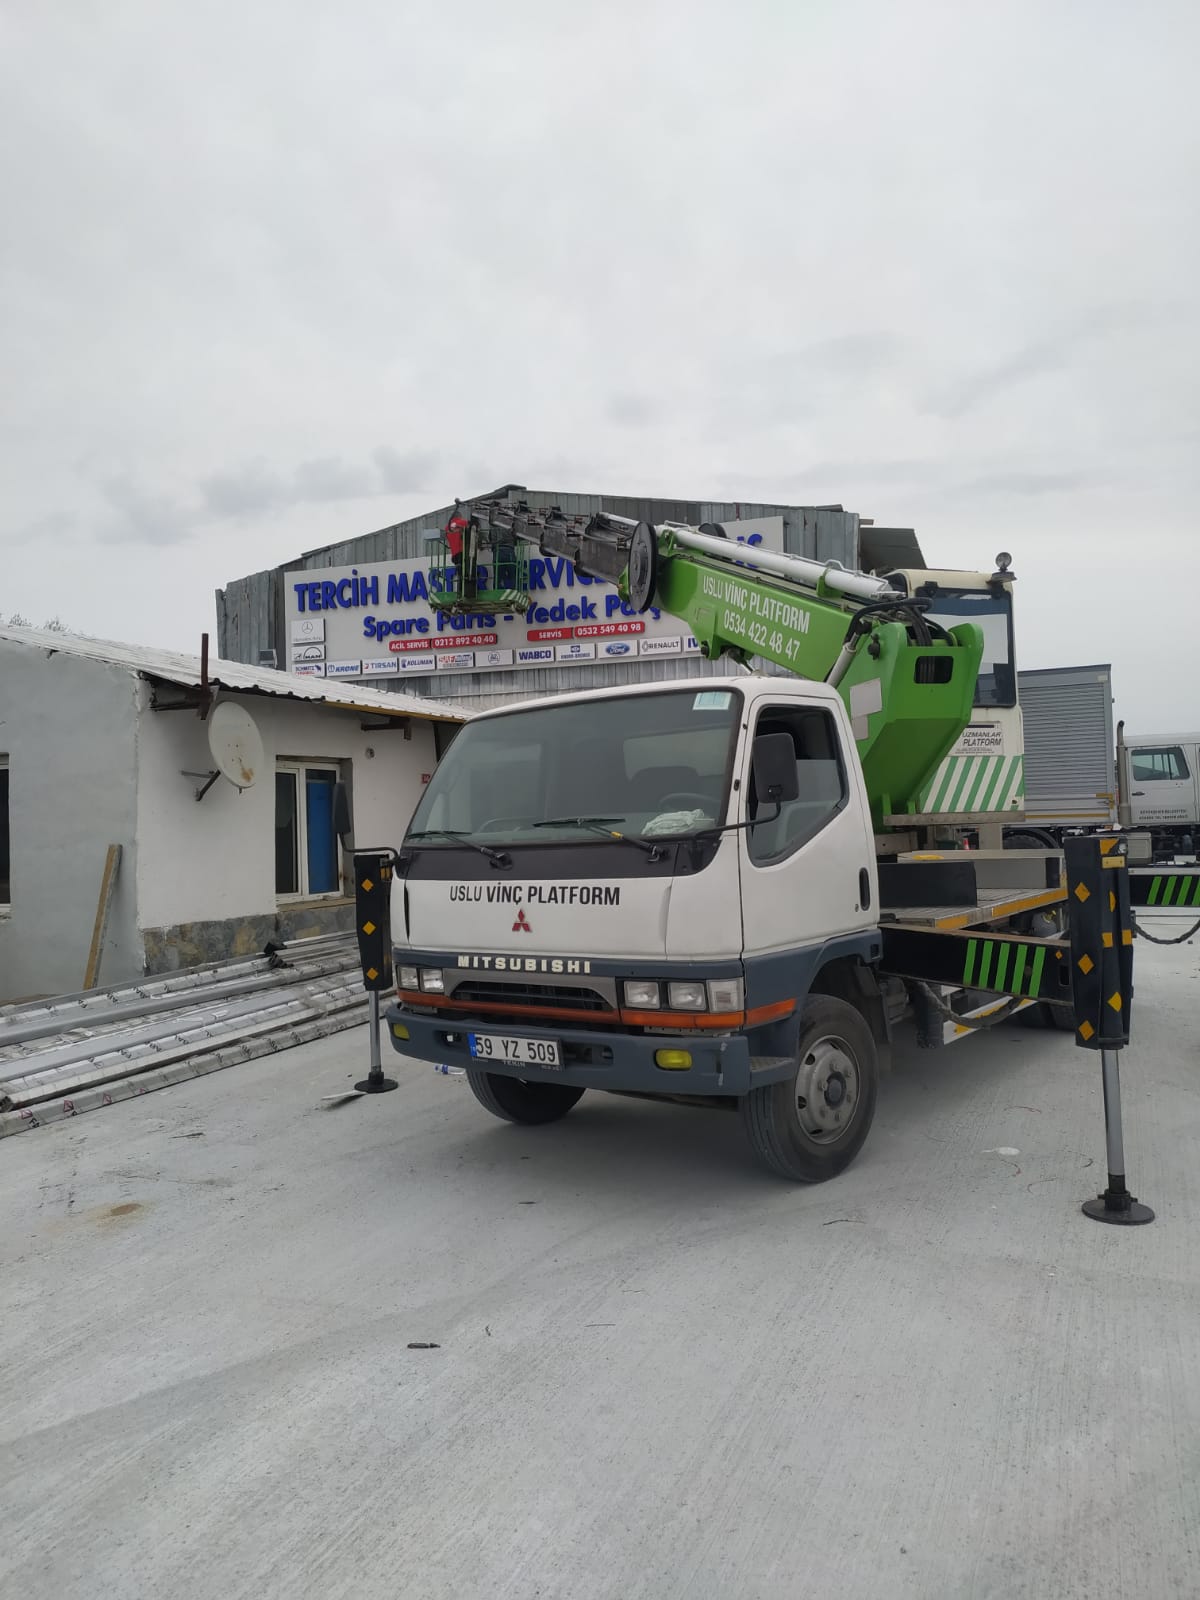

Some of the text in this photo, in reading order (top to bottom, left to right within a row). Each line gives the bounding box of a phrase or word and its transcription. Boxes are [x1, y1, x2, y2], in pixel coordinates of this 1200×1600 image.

[294, 569, 379, 612] TERCİH
[387, 565, 489, 604] MASTR
[703, 576, 811, 634] USLU VİNÇ PLATFORM
[363, 615, 430, 642] Spare
[526, 596, 597, 624] Yedek
[577, 626, 598, 636] 0532
[600, 625, 615, 634] 549
[618, 624, 628, 632] 40
[630, 623, 641, 631] 98
[434, 638, 454, 647] 0212
[456, 637, 470, 645] 892
[472, 636, 482, 644] 40
[483, 635, 494, 643] 40
[724, 609, 801, 661] 0534 422 48 47
[371, 661, 397, 670] TIRSAN
[519, 650, 552, 660] WABCO
[963, 738, 1002, 747] PLATFORM
[450, 882, 621, 906] USLU VİNÇ PLATFORM
[457, 955, 591, 974] MITSUBISHI
[475, 1038, 556, 1063] 59 YZ 509
